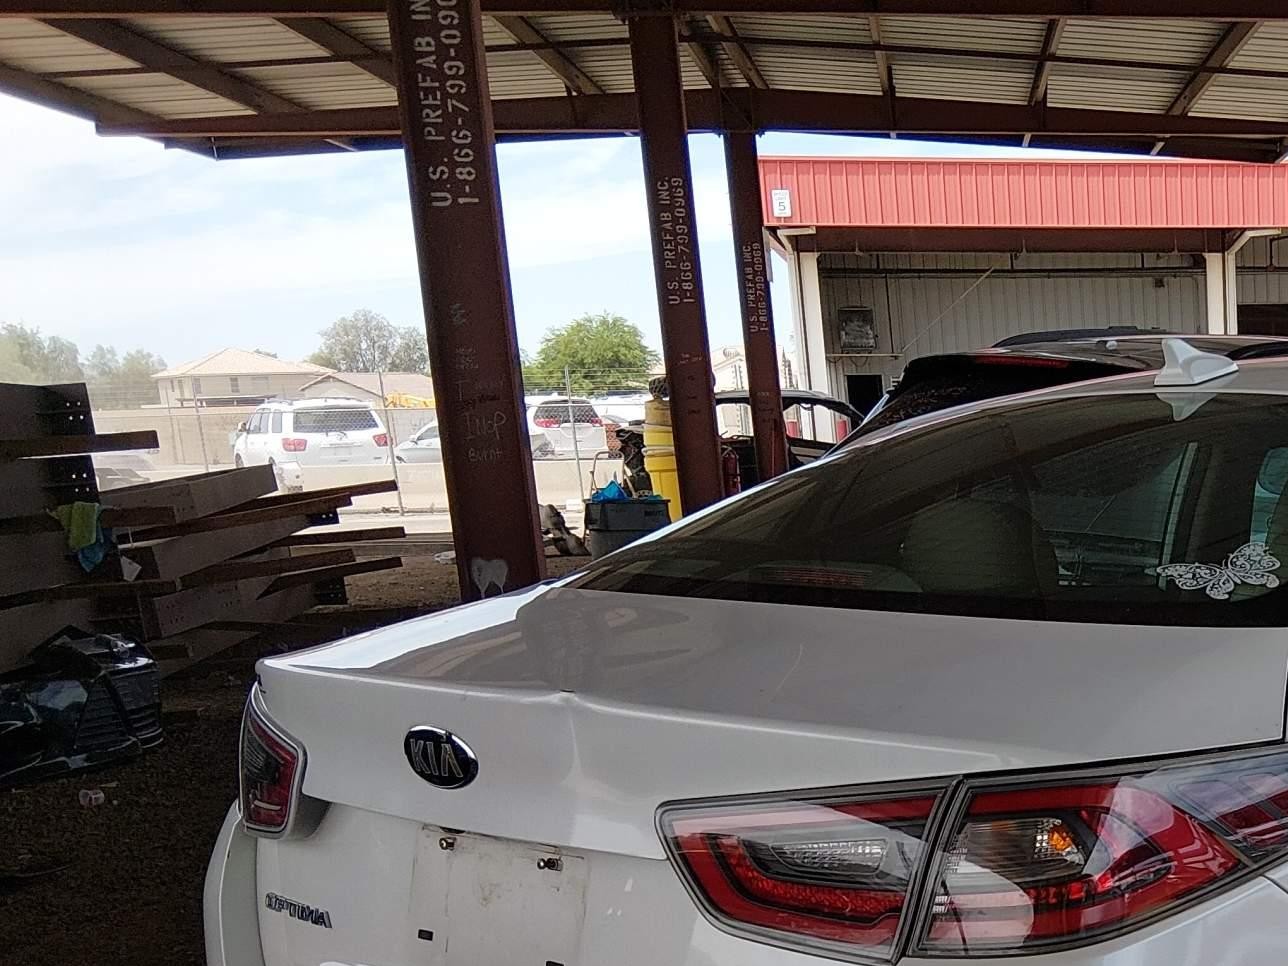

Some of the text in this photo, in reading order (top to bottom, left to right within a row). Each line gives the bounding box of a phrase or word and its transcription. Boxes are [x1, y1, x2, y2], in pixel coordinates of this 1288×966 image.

[414, 36, 446, 141] PREFAB
[428, 156, 453, 208] U.S.
[778, 201, 786, 212] 5
[656, 176, 681, 305] U.S. PREFAB INC.
[670, 177, 696, 304] 1-866-799-0969
[409, 738, 464, 778] KIA
[265, 892, 333, 929] OPTIMA
